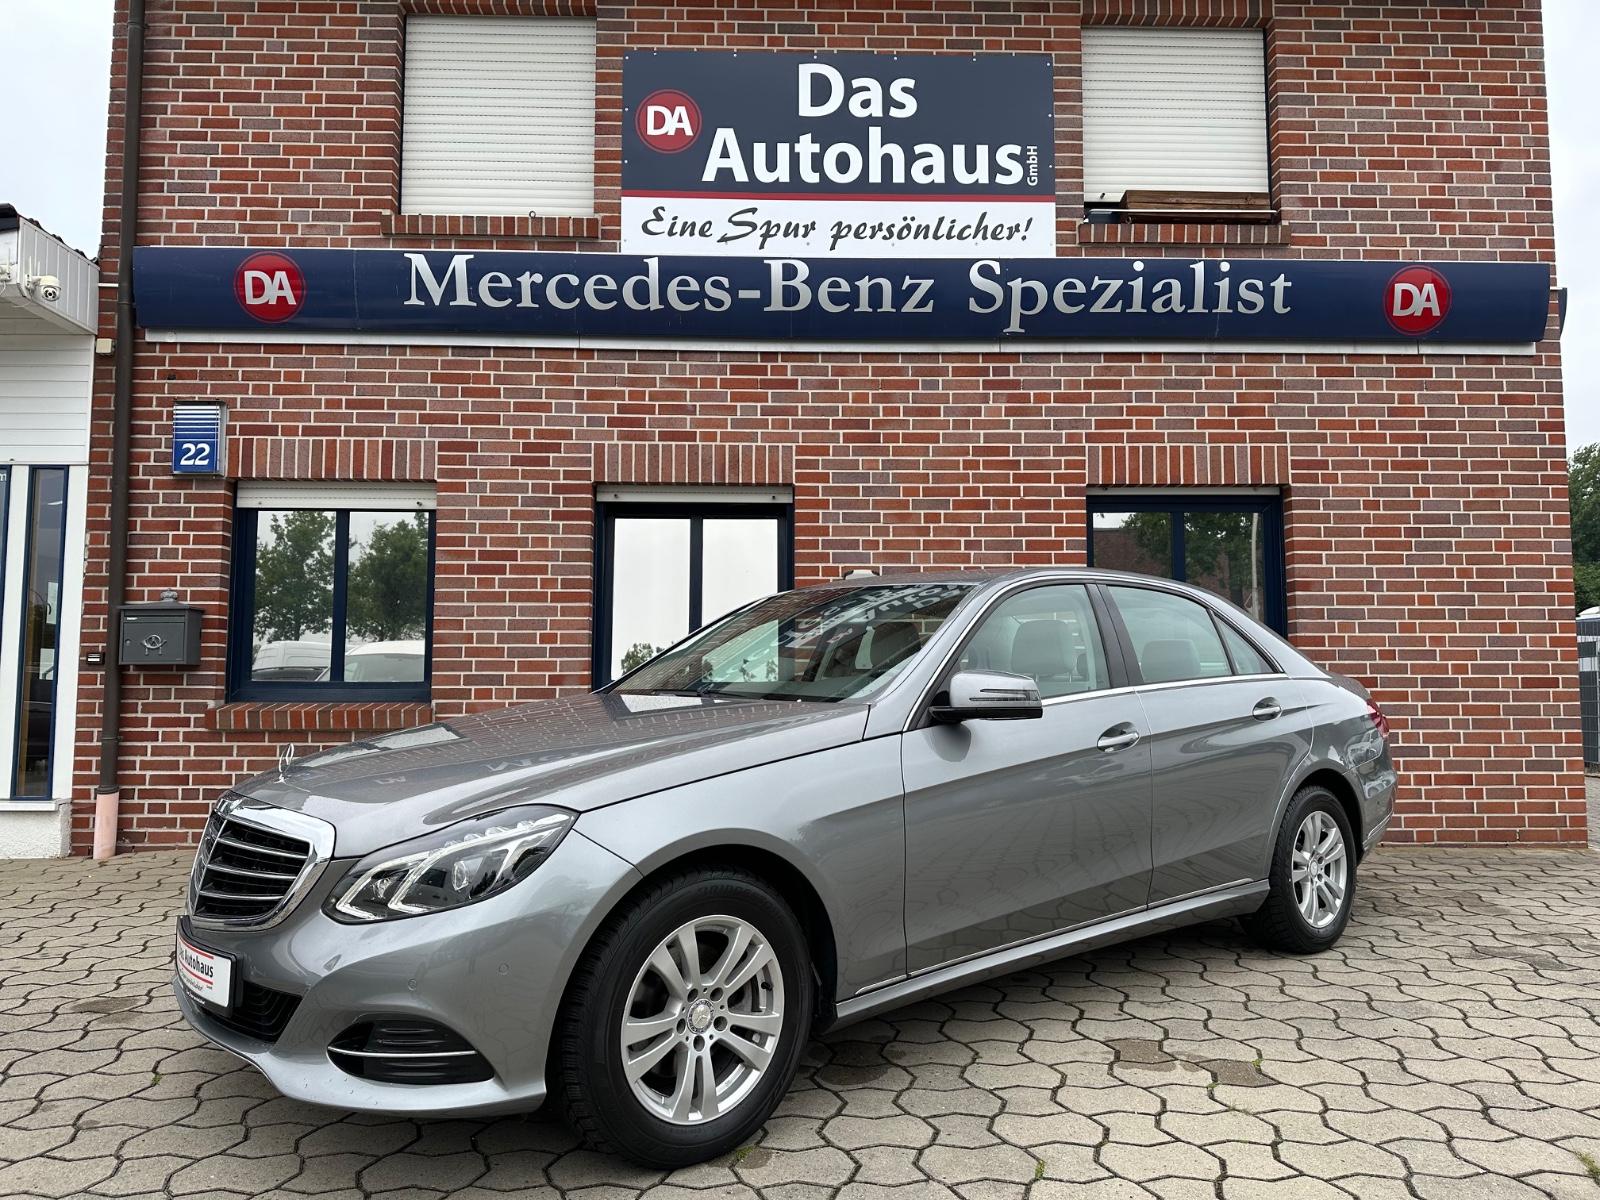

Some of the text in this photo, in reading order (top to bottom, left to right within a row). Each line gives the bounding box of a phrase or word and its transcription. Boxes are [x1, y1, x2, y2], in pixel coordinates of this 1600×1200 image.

[797, 62, 919, 119] Das
[646, 105, 694, 137] DA
[701, 126, 1025, 185] Autohaus
[1026, 144, 1039, 187] GmbH
[641, 206, 1034, 252] Eine Spur persönlicher!
[244, 270, 298, 305] DA
[403, 252, 1293, 334] Mercedes-Benz Spezialist
[1392, 282, 1441, 317] DA
[179, 442, 211, 466] 22
